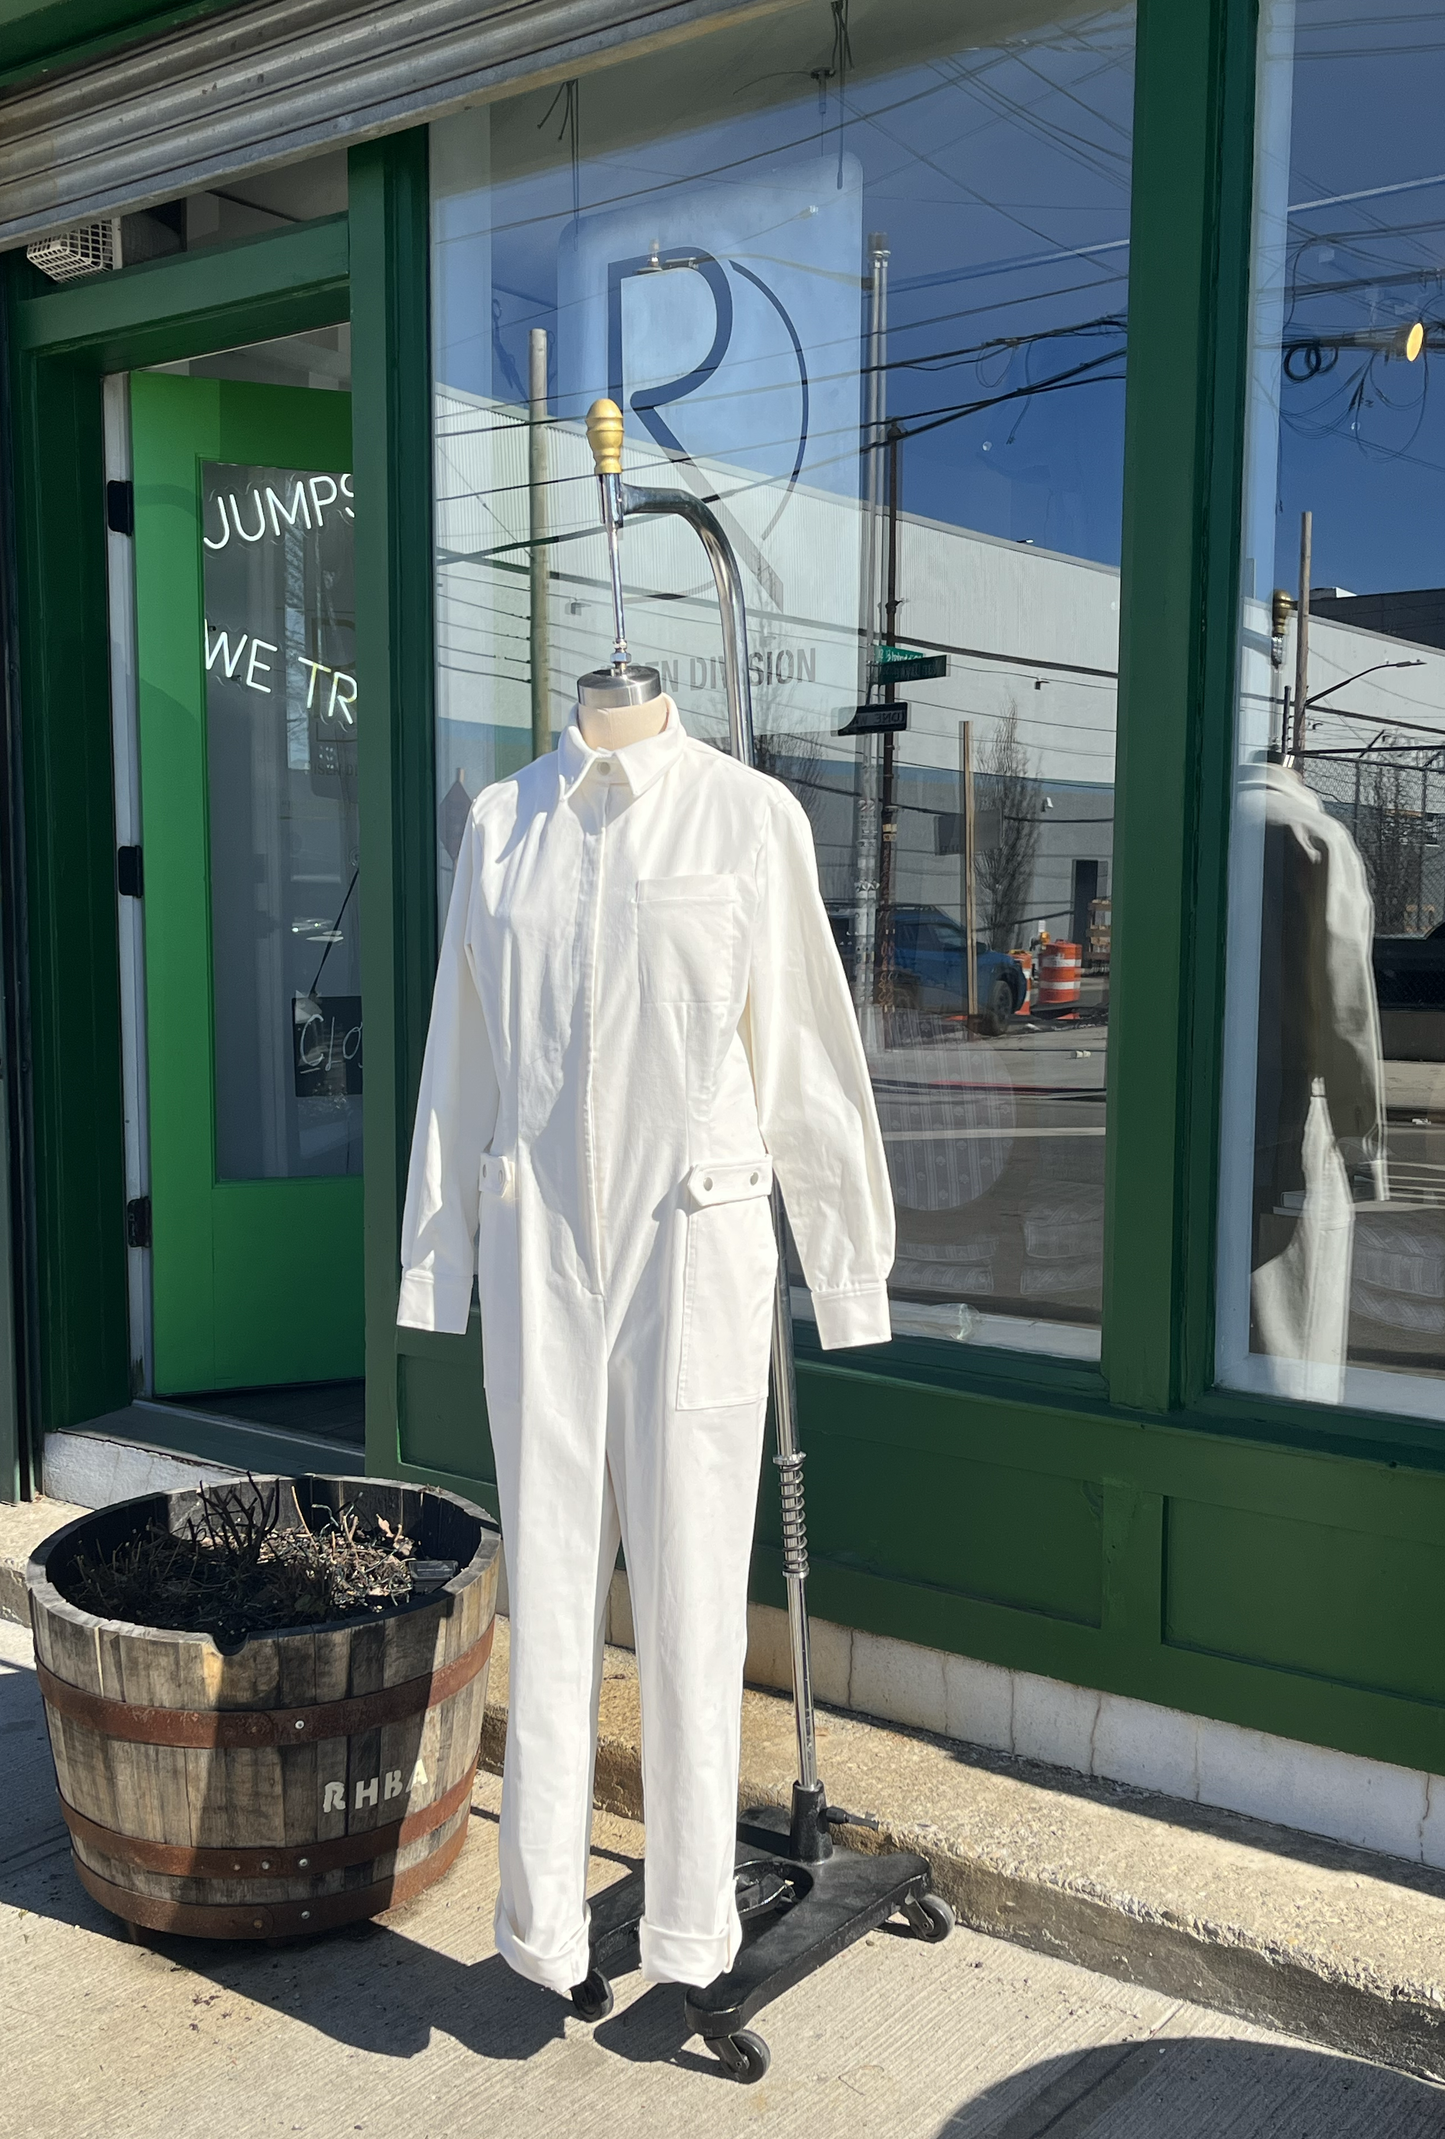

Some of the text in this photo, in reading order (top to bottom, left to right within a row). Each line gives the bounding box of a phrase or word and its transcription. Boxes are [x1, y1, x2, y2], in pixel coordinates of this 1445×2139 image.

[607, 246, 784, 614] R
[204, 618, 358, 724] WE TR
[690, 648, 816, 691] DIVSION
[301, 1013, 363, 1072] Clo
[323, 1758, 428, 1813] RHBA
